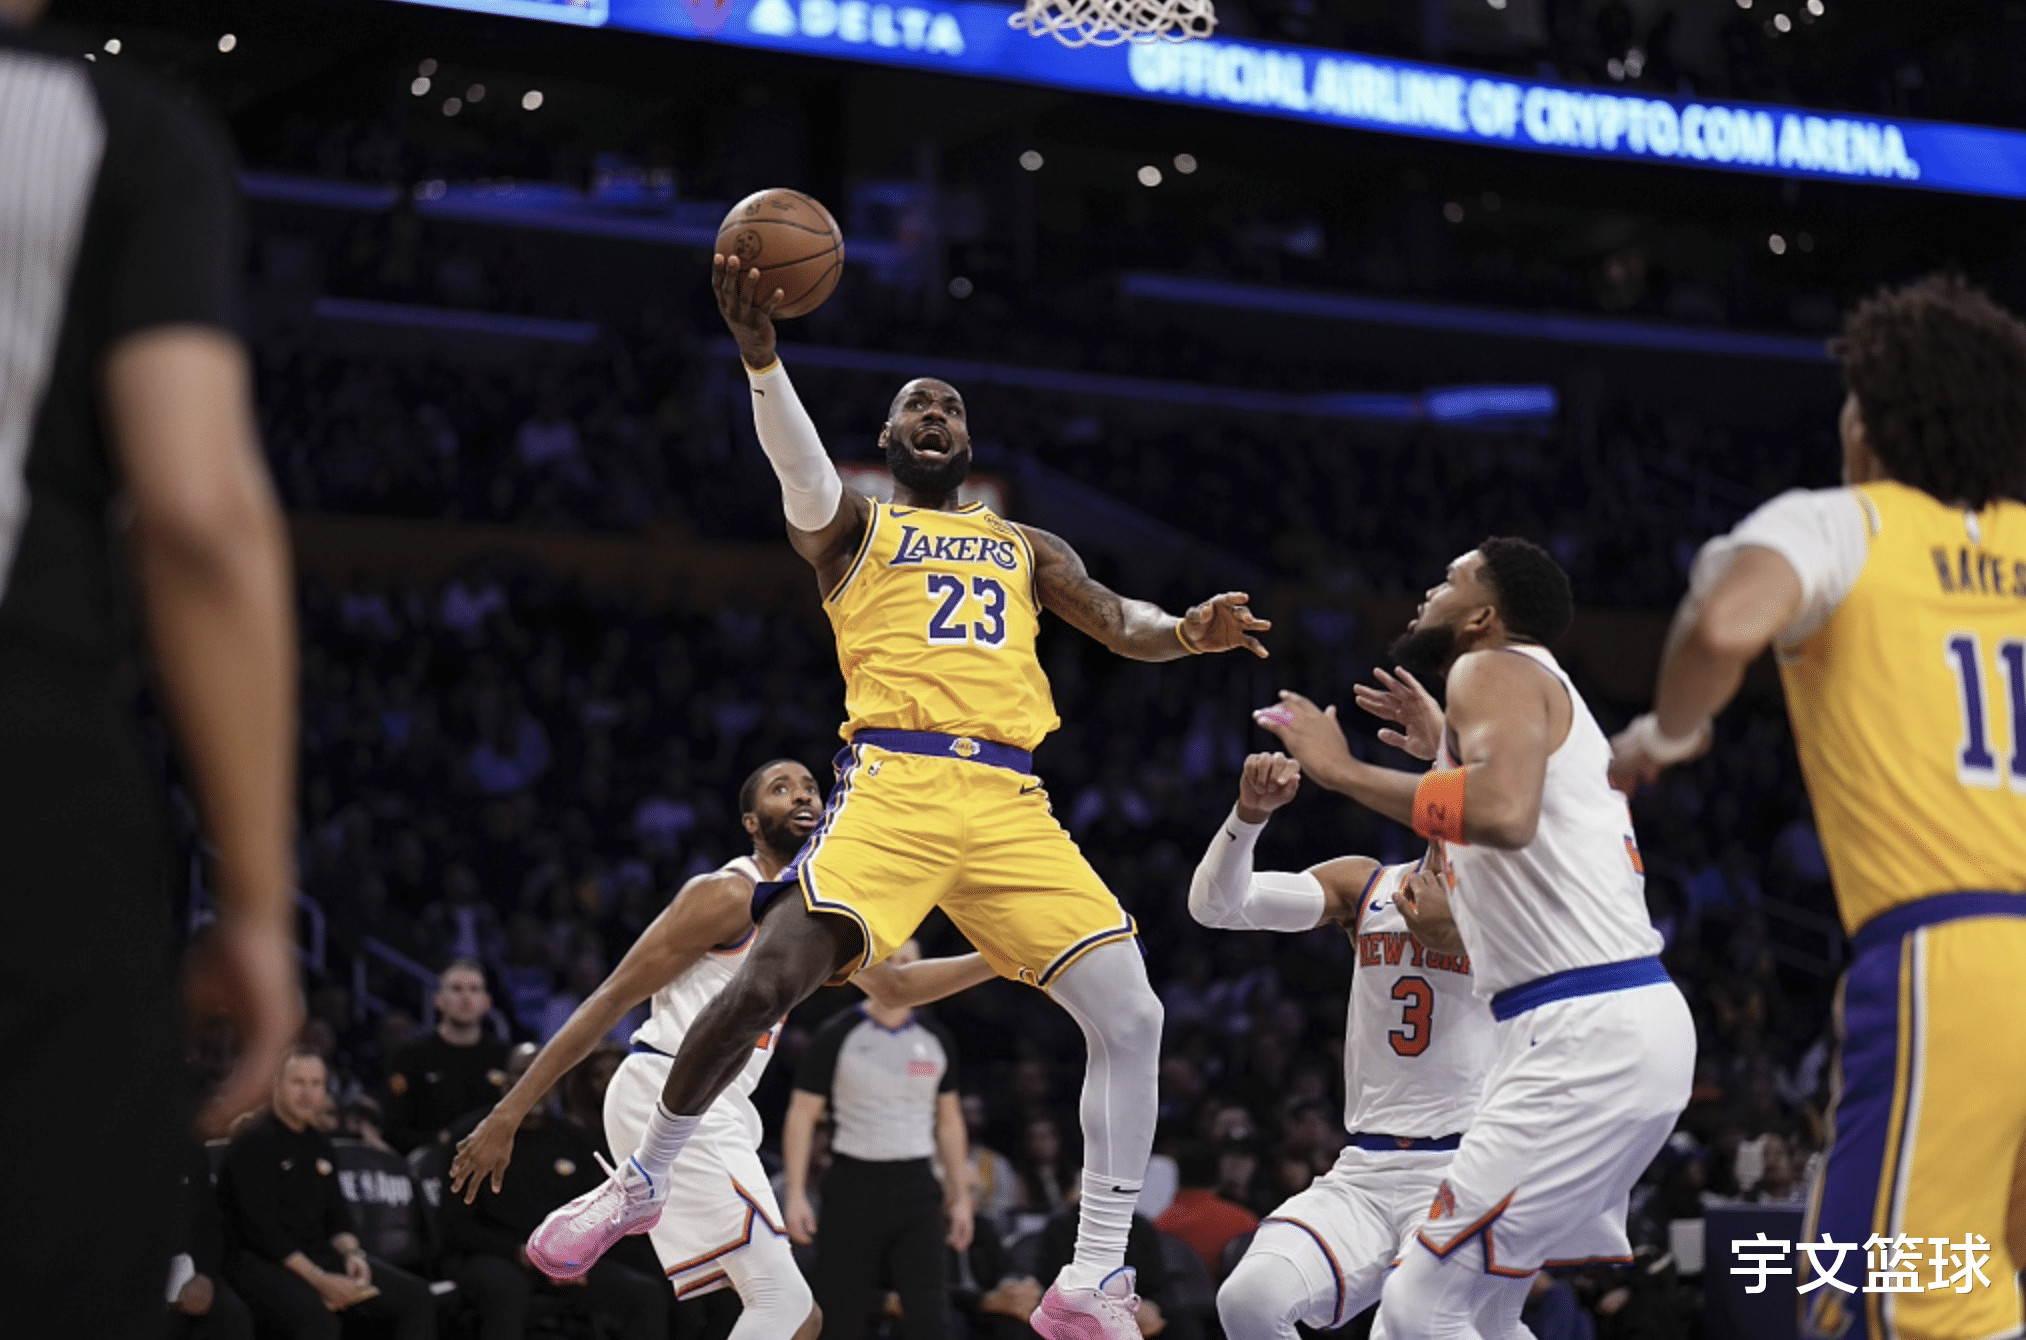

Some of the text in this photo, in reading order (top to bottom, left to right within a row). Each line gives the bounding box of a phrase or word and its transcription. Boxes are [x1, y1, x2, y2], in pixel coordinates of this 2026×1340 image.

[800, 0, 967, 57] DELTA
[1129, 37, 1309, 112] OFFICIAL
[1311, 57, 1469, 133] AIRLINE
[1468, 77, 1521, 139] OF
[1523, 85, 1776, 166] CRYPTO.COM
[888, 524, 1018, 571] LAKERS
[926, 572, 1007, 648] 23
[1359, 932, 1407, 968] NEW
[1388, 975, 1434, 1057] 3
